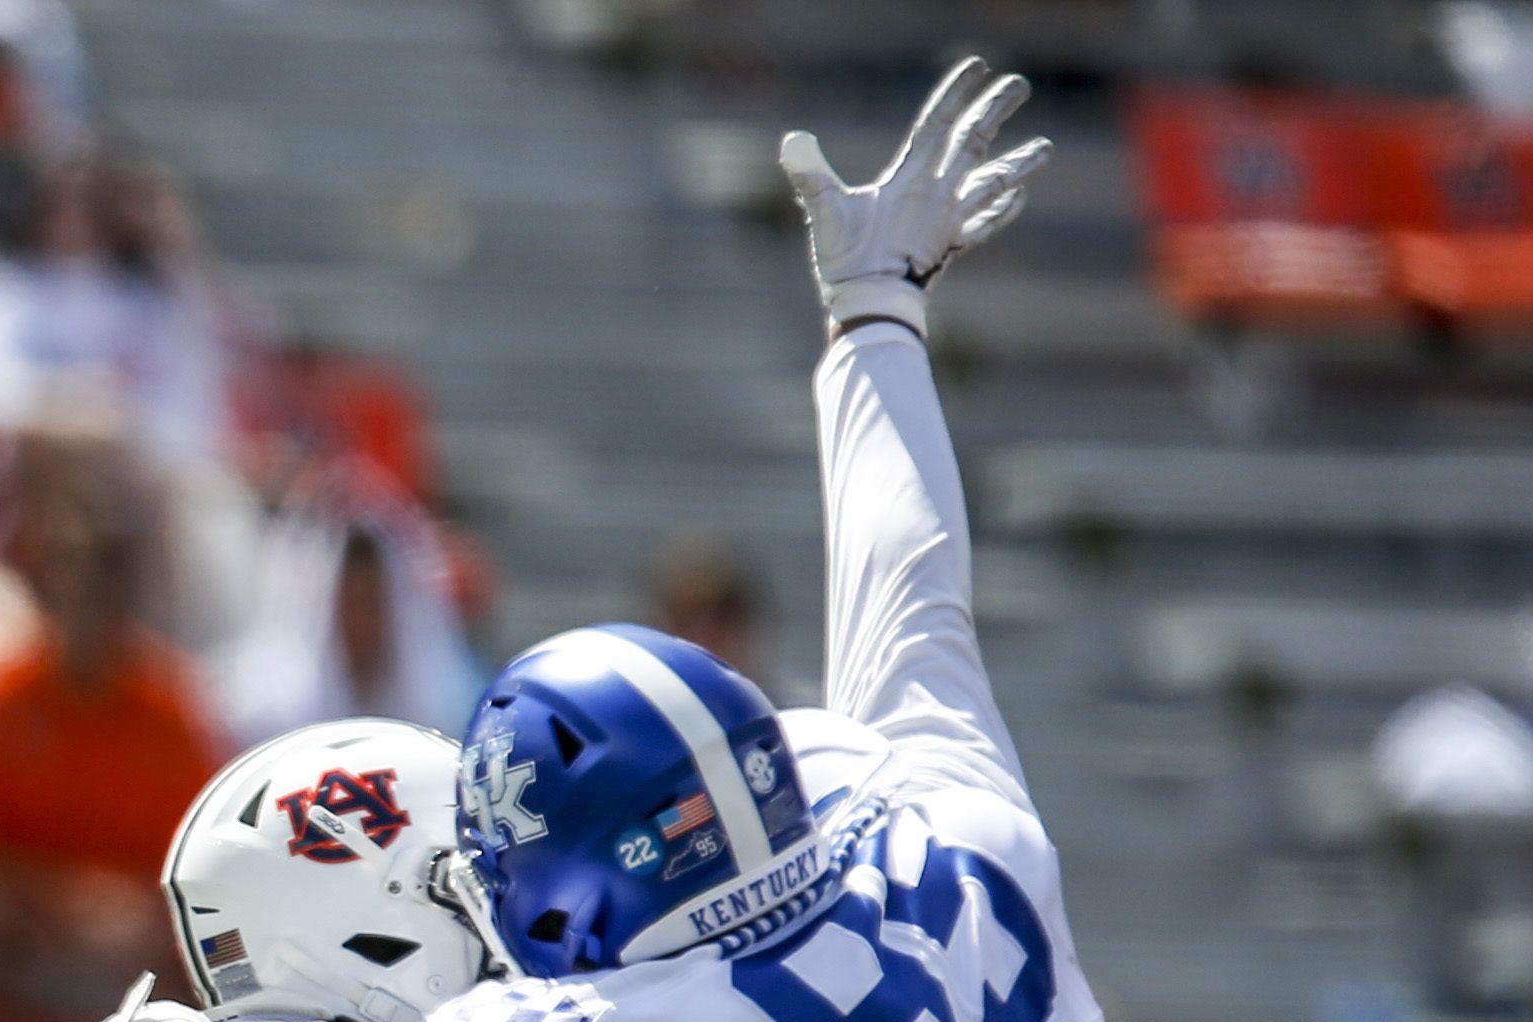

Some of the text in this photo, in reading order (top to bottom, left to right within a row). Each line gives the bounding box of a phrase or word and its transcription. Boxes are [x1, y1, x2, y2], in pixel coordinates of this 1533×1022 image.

[620, 835, 659, 869] 22
[696, 835, 717, 857] 95
[688, 846, 819, 937] KENTUCKY
